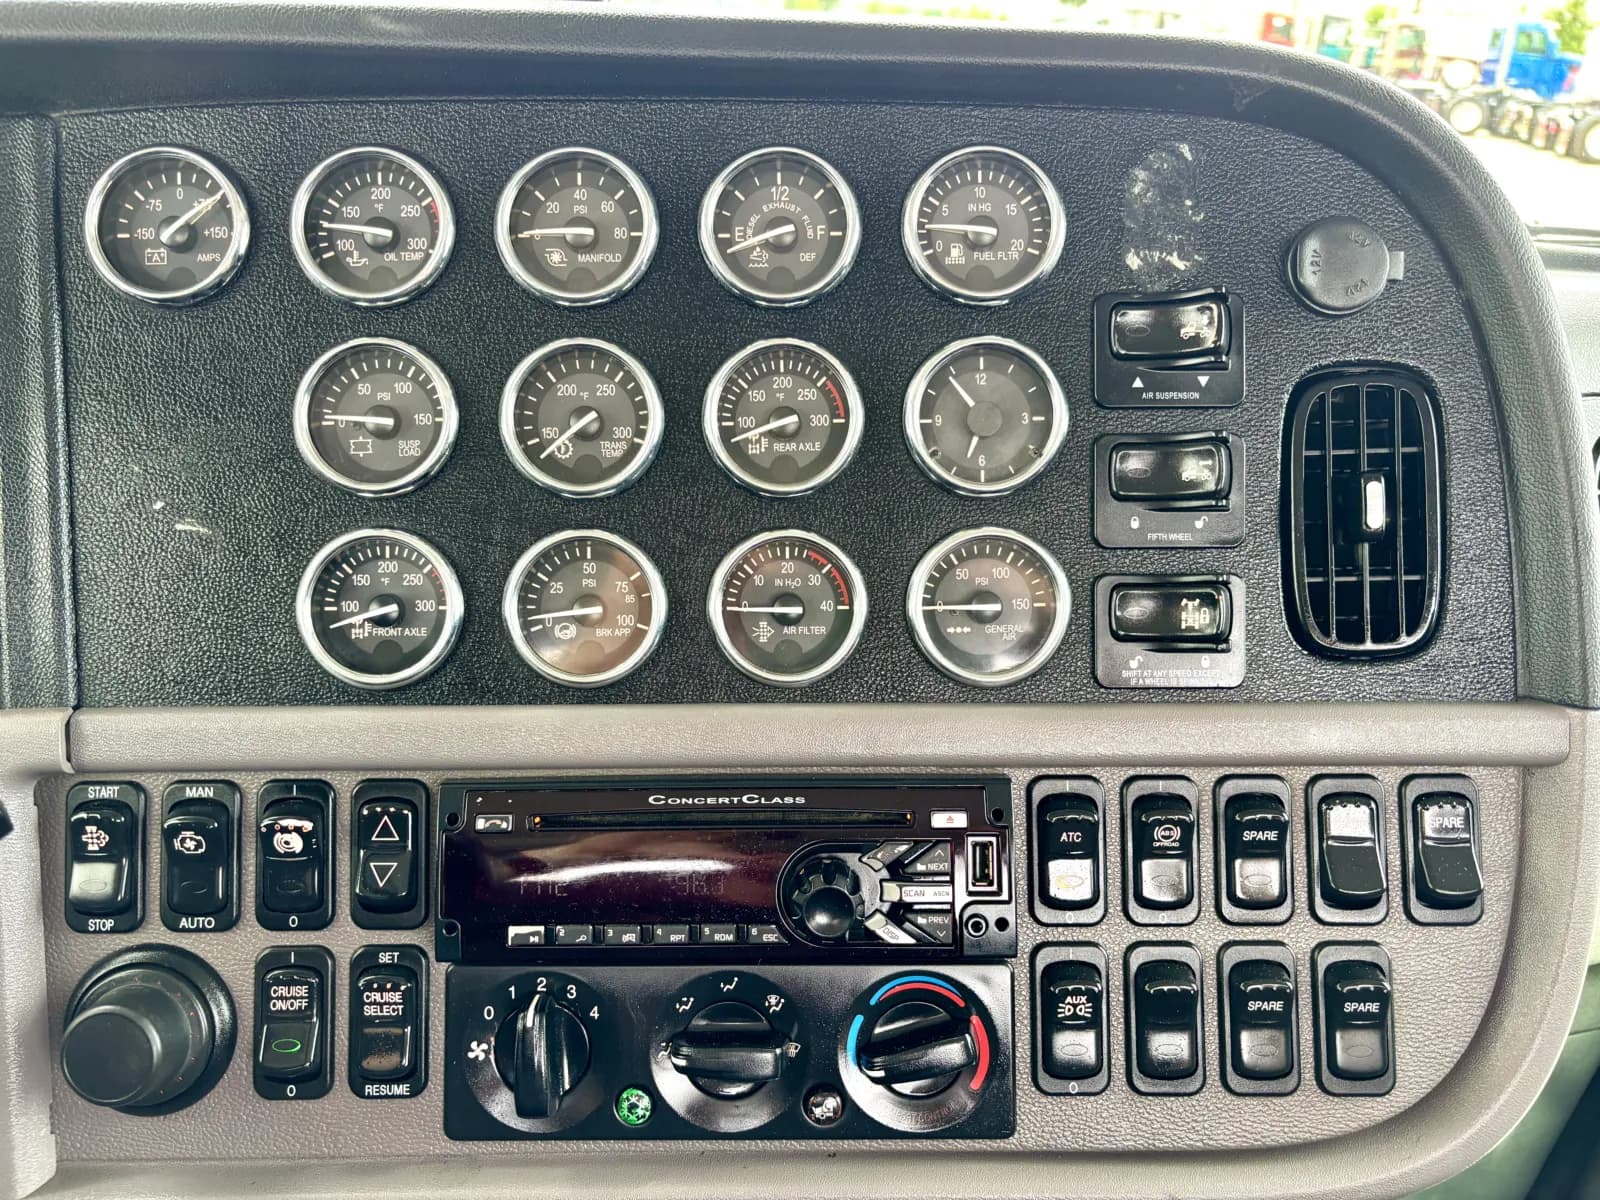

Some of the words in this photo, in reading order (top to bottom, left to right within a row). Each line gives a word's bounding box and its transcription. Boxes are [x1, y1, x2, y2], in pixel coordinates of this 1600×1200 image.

[176, 188, 184, 200] 0
[370, 188, 391, 200] 200
[573, 188, 588, 201] 40
[770, 186, 790, 201] 1/2
[975, 187, 986, 199] 10
[145, 199, 163, 212] -75
[400, 205, 421, 217] 250
[546, 201, 560, 214] 20
[573, 205, 588, 214] PSI
[600, 200, 615, 213] 60
[762, 202, 802, 215] EXHAUST
[942, 205, 949, 216] 5
[968, 203, 977, 212] IN
[979, 203, 992, 212] HG
[1006, 204, 1017, 215] 15
[341, 206, 360, 218] 150
[203, 226, 229, 239] +150
[613, 227, 628, 239] 80
[801, 215, 814, 239] FLUID
[817, 225, 826, 240] F
[133, 227, 155, 240] -150
[735, 227, 745, 241] E
[335, 239, 354, 251] 100
[407, 238, 428, 250] 300
[935, 240, 943, 252] 0
[1010, 239, 1024, 251] 20
[197, 251, 222, 263] AMPS
[383, 251, 398, 262] OIL
[399, 251, 424, 262] TEMP
[578, 253, 622, 262] MANIFOLD
[800, 252, 817, 262] DEF
[973, 251, 995, 261] FUEL
[997, 251, 1019, 261] FLTR
[772, 377, 793, 389] 200
[975, 373, 986, 385] 12
[357, 383, 371, 395] 50
[393, 382, 412, 394] 100
[557, 384, 577, 396] 200
[596, 384, 616, 396] 250
[377, 392, 391, 401] PSI
[748, 390, 766, 402] 150
[797, 388, 817, 401] 250
[1142, 391, 1154, 400] AIR
[1155, 391, 1200, 400] SUSPENSION
[413, 414, 433, 426] 150
[737, 416, 755, 428] 100
[809, 414, 830, 426] 300
[935, 415, 942, 426] 9
[1021, 412, 1029, 424] 3
[541, 427, 559, 439] 150
[612, 427, 632, 439] 300
[398, 440, 421, 449] SUSP
[600, 441, 627, 450] TRANS
[773, 442, 797, 452] REAR
[798, 442, 821, 452] AXLE
[398, 448, 421, 457] LOAD
[600, 449, 624, 458] TEMP
[978, 454, 986, 466] 6
[1147, 533, 1168, 541] FIFTH
[1169, 533, 1193, 541] WHEEL
[377, 561, 398, 573] 200
[583, 562, 597, 574] 50
[781, 562, 794, 574] 20
[992, 567, 1010, 579] 100
[352, 574, 370, 586] 150
[403, 573, 423, 586] 250
[753, 574, 764, 586] 10
[808, 574, 821, 586] 30
[955, 568, 969, 580] 50
[582, 578, 596, 587] PSI
[615, 581, 629, 593] 75
[774, 578, 783, 587] IN
[975, 577, 989, 586] PSI
[550, 582, 563, 594] 25
[625, 594, 635, 603] 85
[1012, 598, 1030, 610] 150
[340, 601, 359, 613] 100
[415, 600, 435, 612] 300
[820, 600, 833, 612] 40
[616, 614, 635, 626] 100
[372, 627, 402, 637] FRONT
[403, 627, 428, 637] AXLE
[596, 627, 613, 637] BRK
[614, 627, 631, 637] APP
[783, 626, 797, 635] AIR
[799, 626, 826, 635] FILTER
[984, 624, 1024, 634] GENERAL
[1002, 633, 1016, 641] AIR
[88, 786, 119, 799] START
[185, 786, 214, 798] MAN
[1429, 816, 1465, 829] SPARE
[1060, 832, 1082, 842] ATC
[1242, 830, 1279, 841] SPARE
[927, 863, 949, 871] NEXT
[903, 889, 925, 897] SCAN
[88, 918, 114, 931] STOP
[179, 917, 215, 929] AUTO
[928, 916, 949, 924] PREV
[670, 934, 686, 942] RPT
[714, 934, 733, 942] RDM
[762, 934, 778, 942] ESC
[378, 952, 400, 963] SET
[536, 977, 547, 992] 2
[270, 985, 309, 997] CRUISE
[508, 985, 516, 1000] 1
[566, 984, 577, 999] 3
[363, 991, 403, 1004] CRUISE
[1065, 995, 1087, 1004] AUX
[270, 999, 309, 1011] ON/OFF
[363, 1005, 404, 1016] SELECT
[1247, 1000, 1285, 1012] SPARE
[1343, 1002, 1381, 1013] SPARE
[483, 1005, 495, 1020] 0
[589, 1005, 600, 1020] 4
[365, 1084, 410, 1096] RESUME
